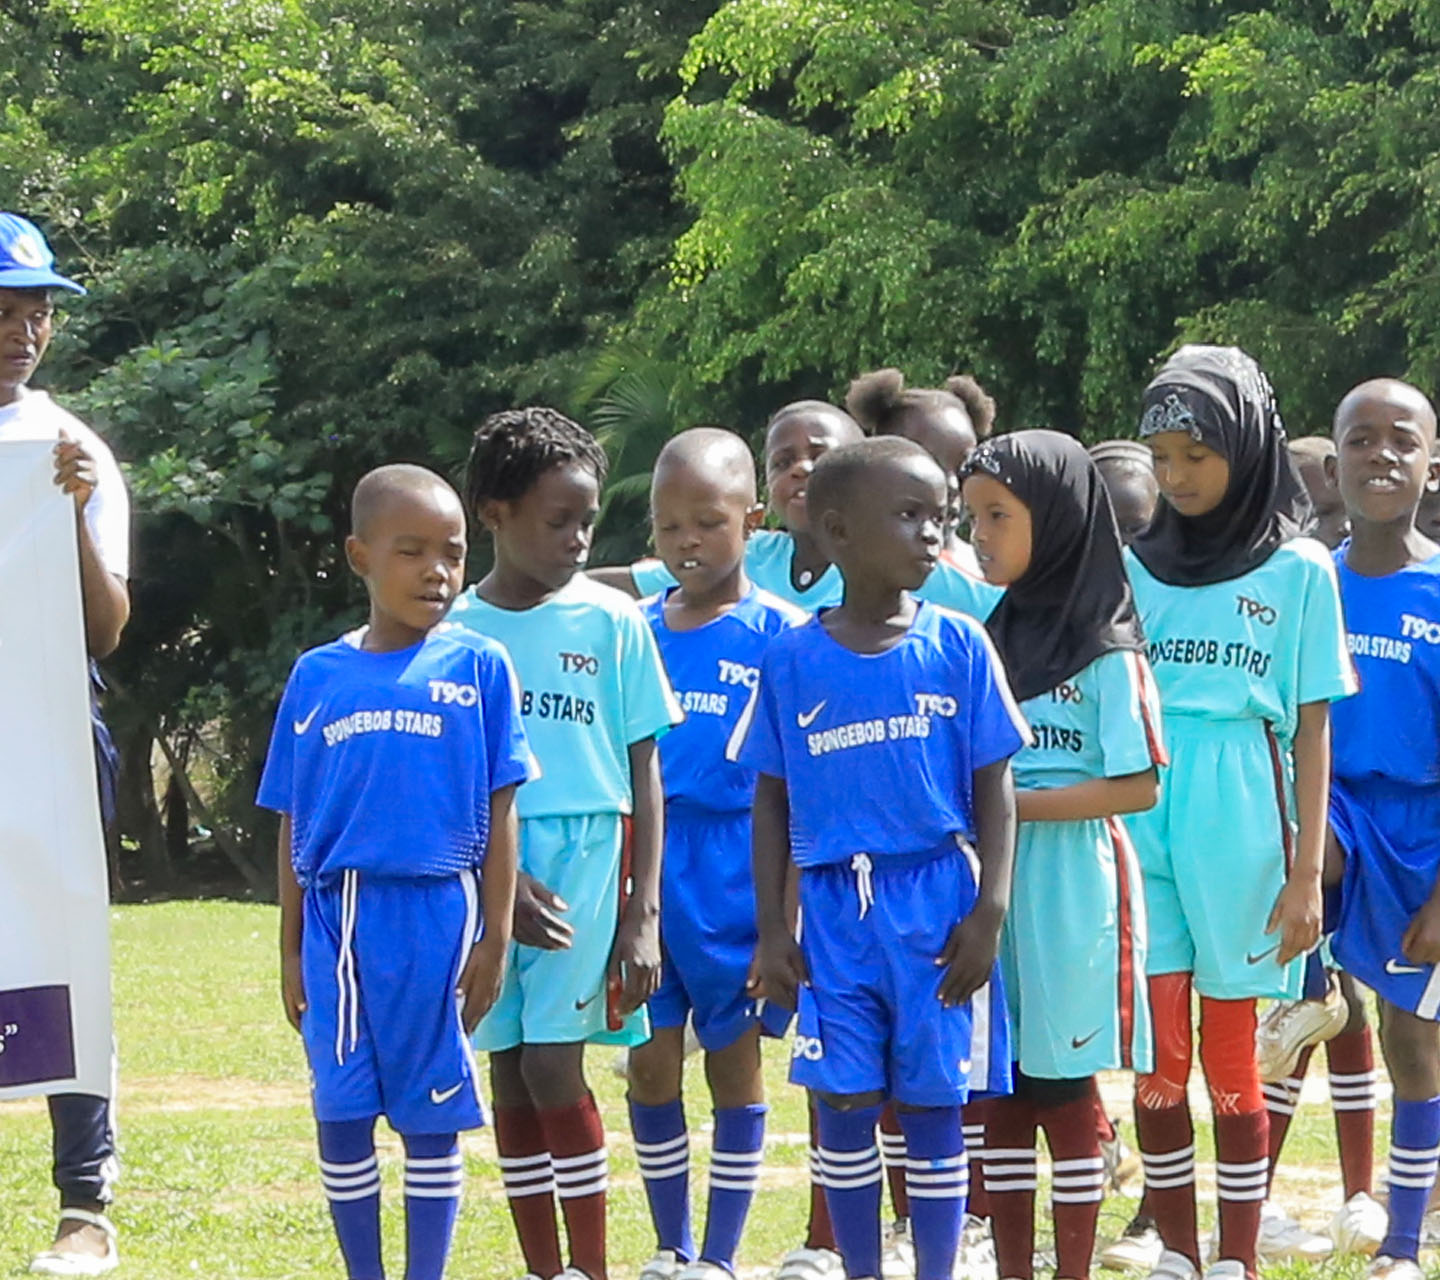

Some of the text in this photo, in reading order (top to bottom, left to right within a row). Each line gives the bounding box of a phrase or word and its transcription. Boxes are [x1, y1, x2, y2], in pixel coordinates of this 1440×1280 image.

[428, 680, 478, 708] T90
[539, 692, 595, 725] STARS
[683, 691, 728, 716] STARS
[394, 709, 442, 738] STARS
[808, 719, 885, 757] SPONGEBOB
